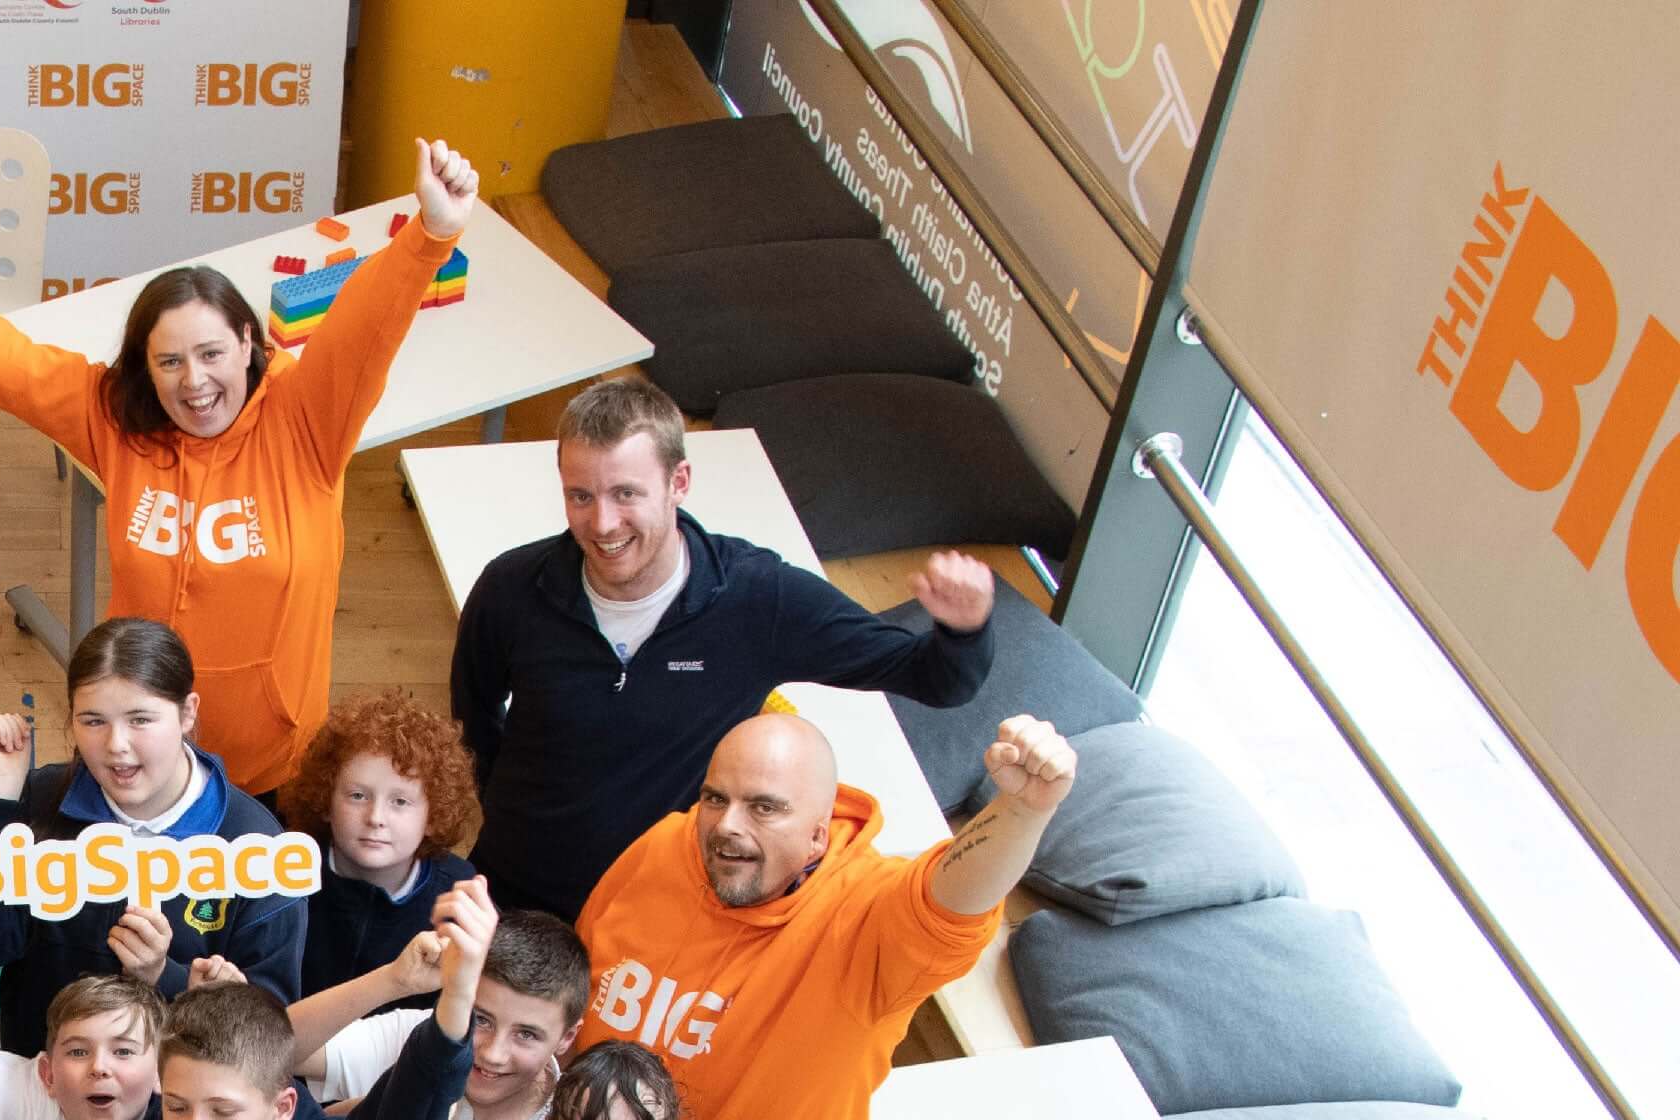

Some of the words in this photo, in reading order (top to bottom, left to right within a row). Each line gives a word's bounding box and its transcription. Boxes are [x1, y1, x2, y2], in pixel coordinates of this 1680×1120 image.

[111, 7, 138, 16] South
[140, 6, 170, 15] Dublin
[120, 18, 160, 26] Libraries
[28, 65, 39, 107] THINK
[40, 63, 131, 107] BIG
[132, 63, 144, 107] SPACE
[195, 64, 207, 107] THINK
[207, 62, 298, 106] BIG
[298, 63, 311, 106] SPACE
[48, 172, 128, 215] BIG
[128, 172, 140, 214] SPACE
[190, 172, 202, 214] THINK
[202, 171, 292, 214] BIG
[291, 171, 304, 213] SPACE
[1416, 160, 1530, 387] THINK
[126, 486, 157, 544] THINK
[243, 496, 266, 557] SPACE
[599, 959, 724, 1060] BIG
